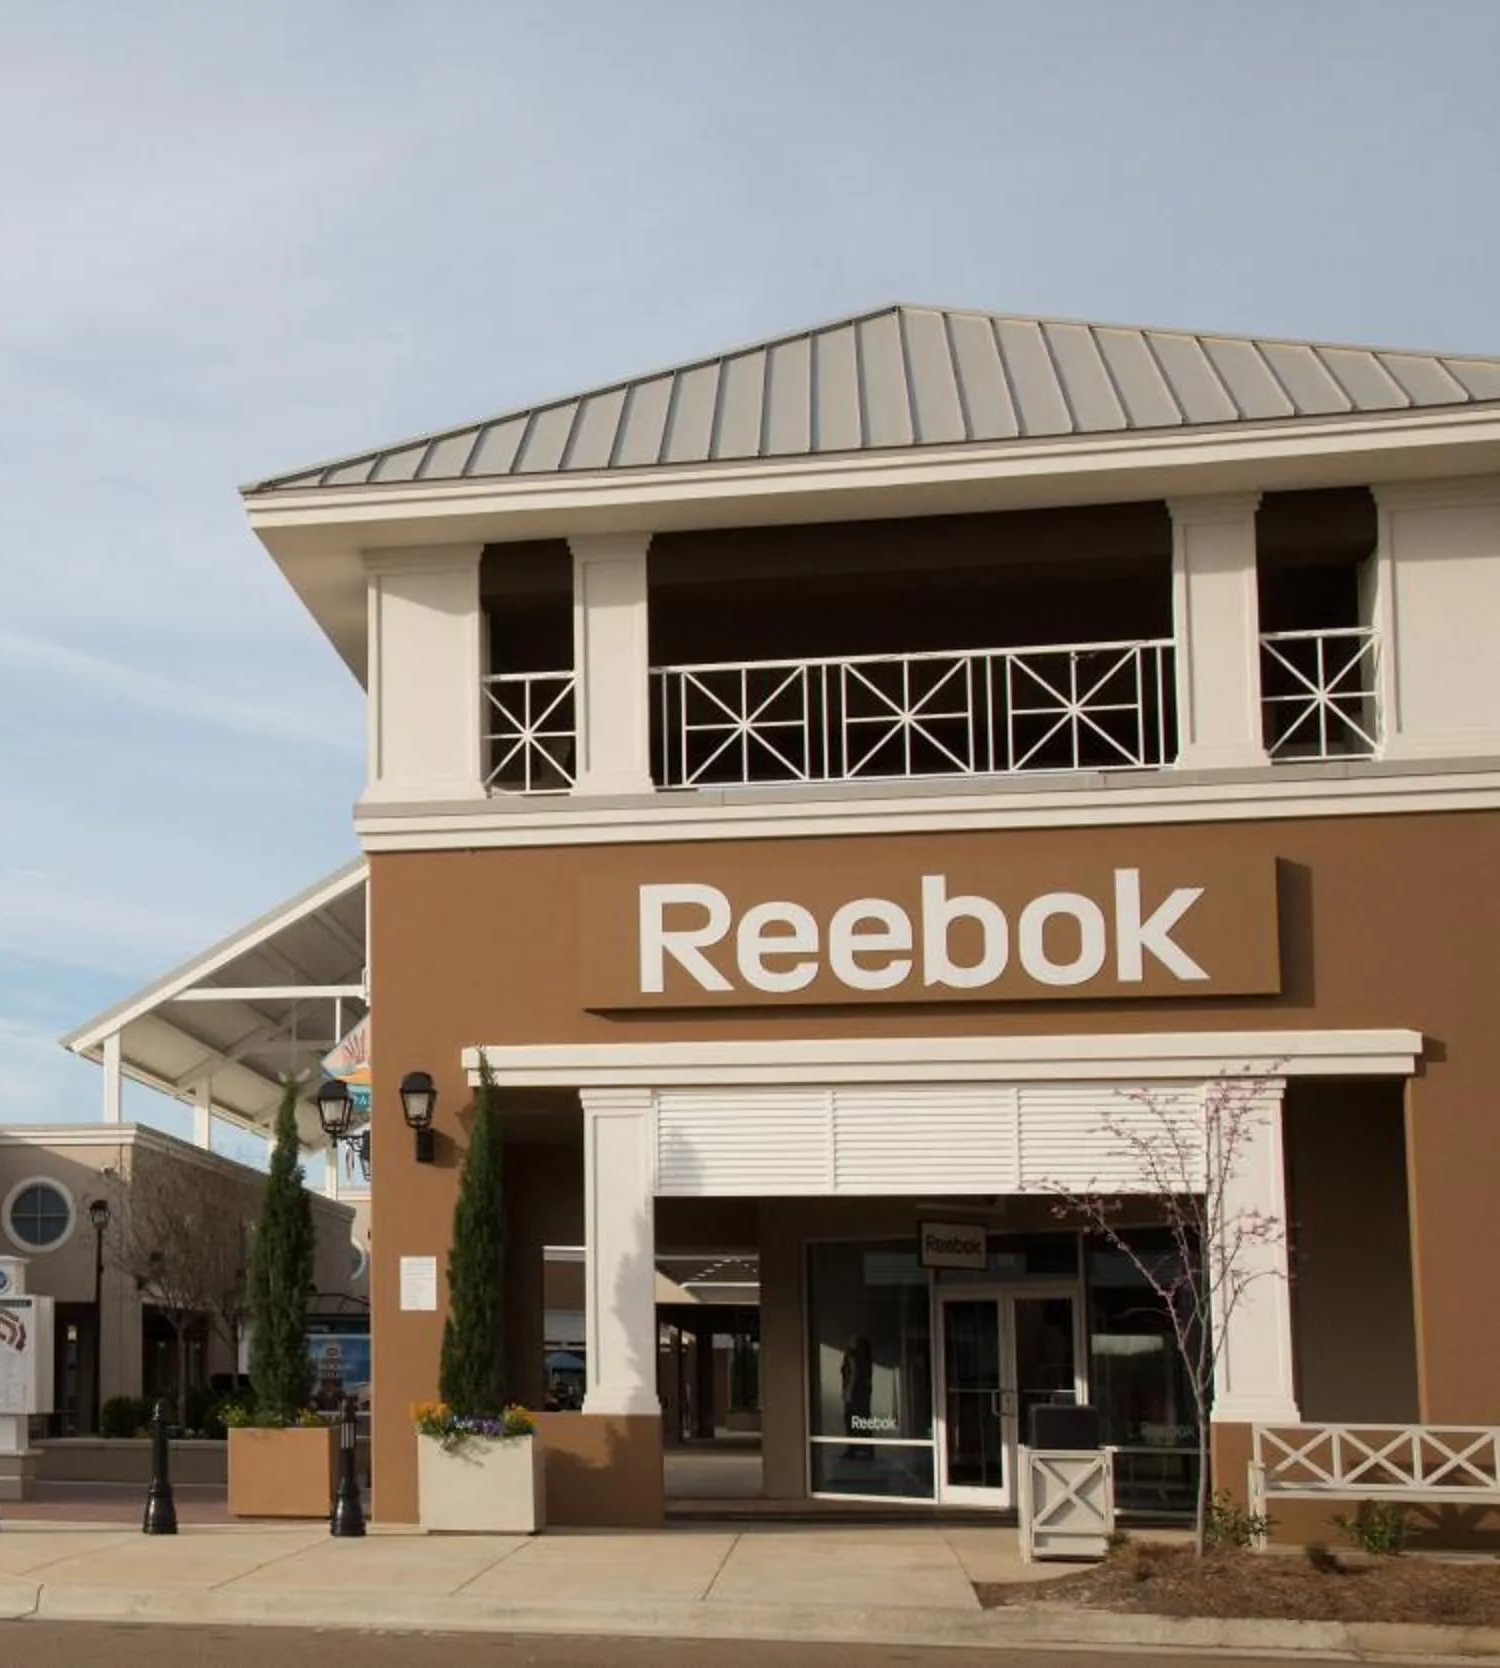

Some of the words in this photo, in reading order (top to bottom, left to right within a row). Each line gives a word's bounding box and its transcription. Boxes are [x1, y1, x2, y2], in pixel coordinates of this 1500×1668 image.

[639, 868, 1211, 993] Reebok
[925, 1234, 983, 1256] Reebok
[851, 1415, 897, 1430] Reebok
